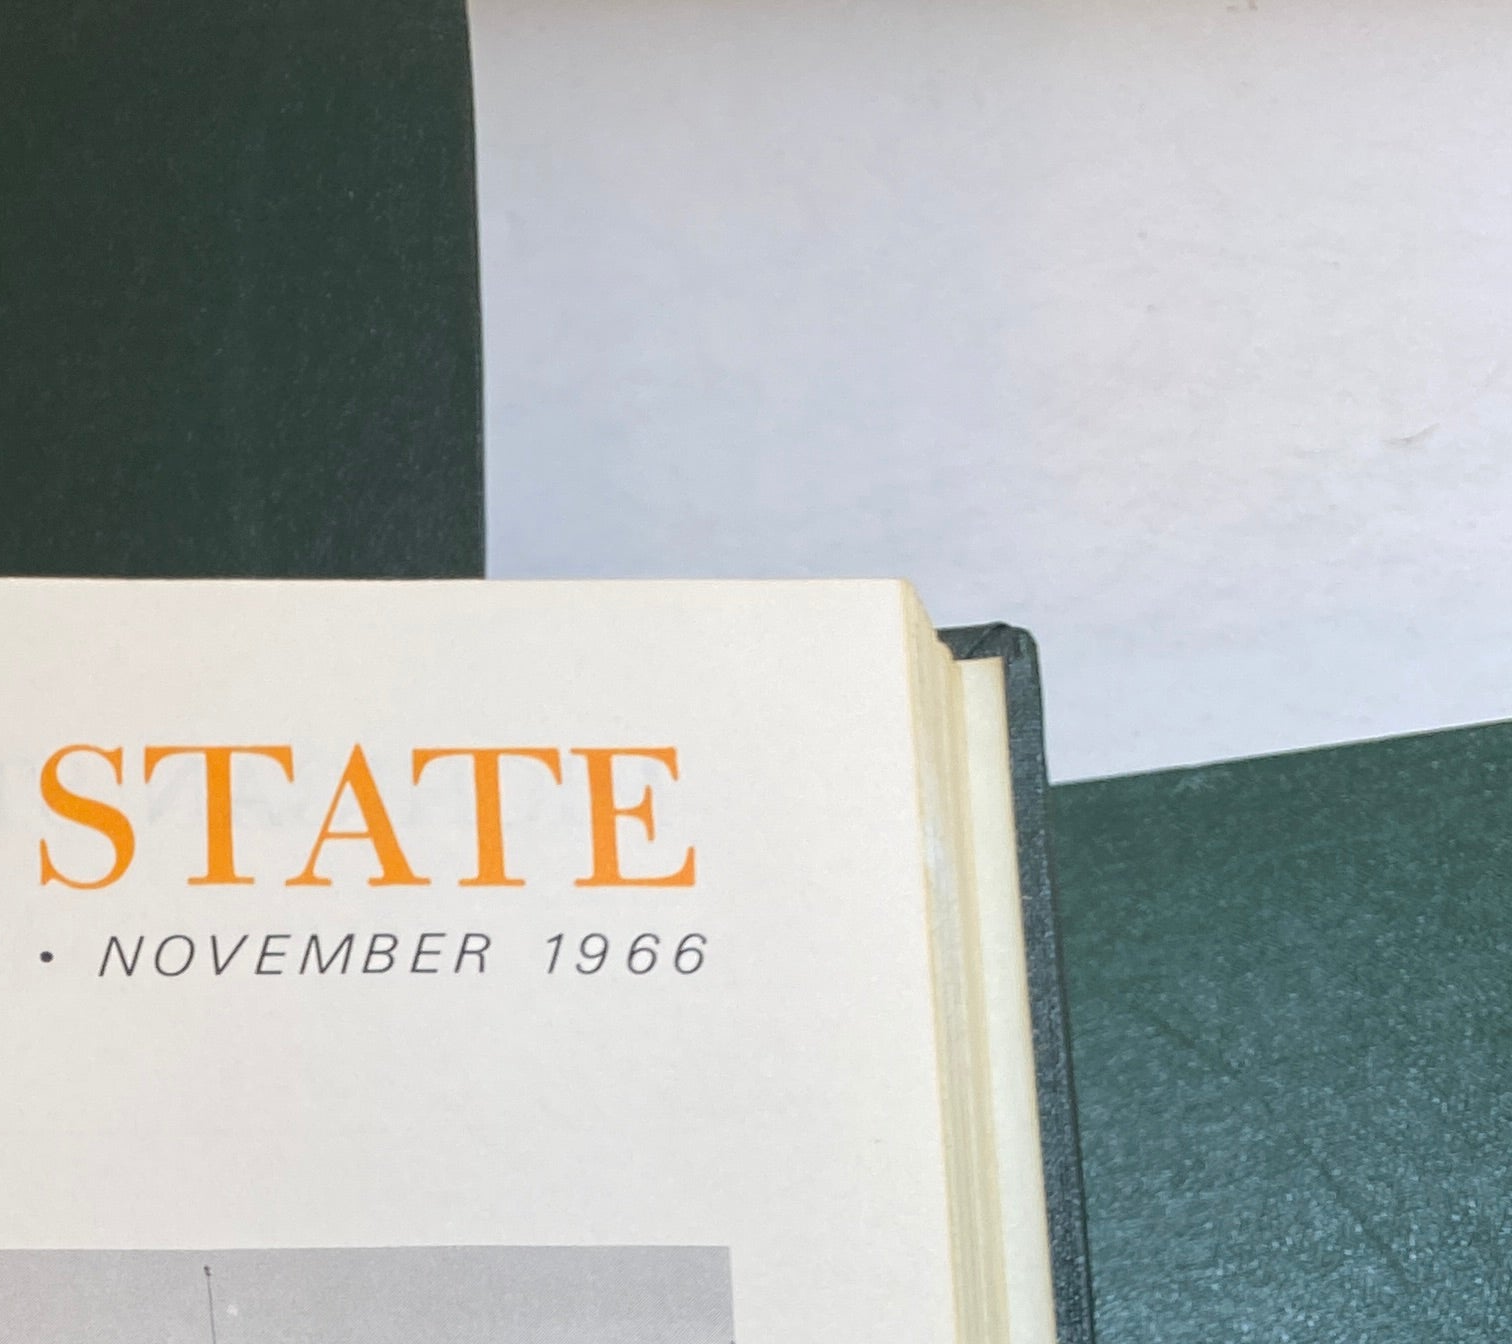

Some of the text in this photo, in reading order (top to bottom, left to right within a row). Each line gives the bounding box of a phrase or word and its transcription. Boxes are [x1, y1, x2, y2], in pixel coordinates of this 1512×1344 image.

[39, 744, 695, 890] STATE
[98, 932, 492, 978] NOVEMBER
[546, 932, 708, 976] 1966
